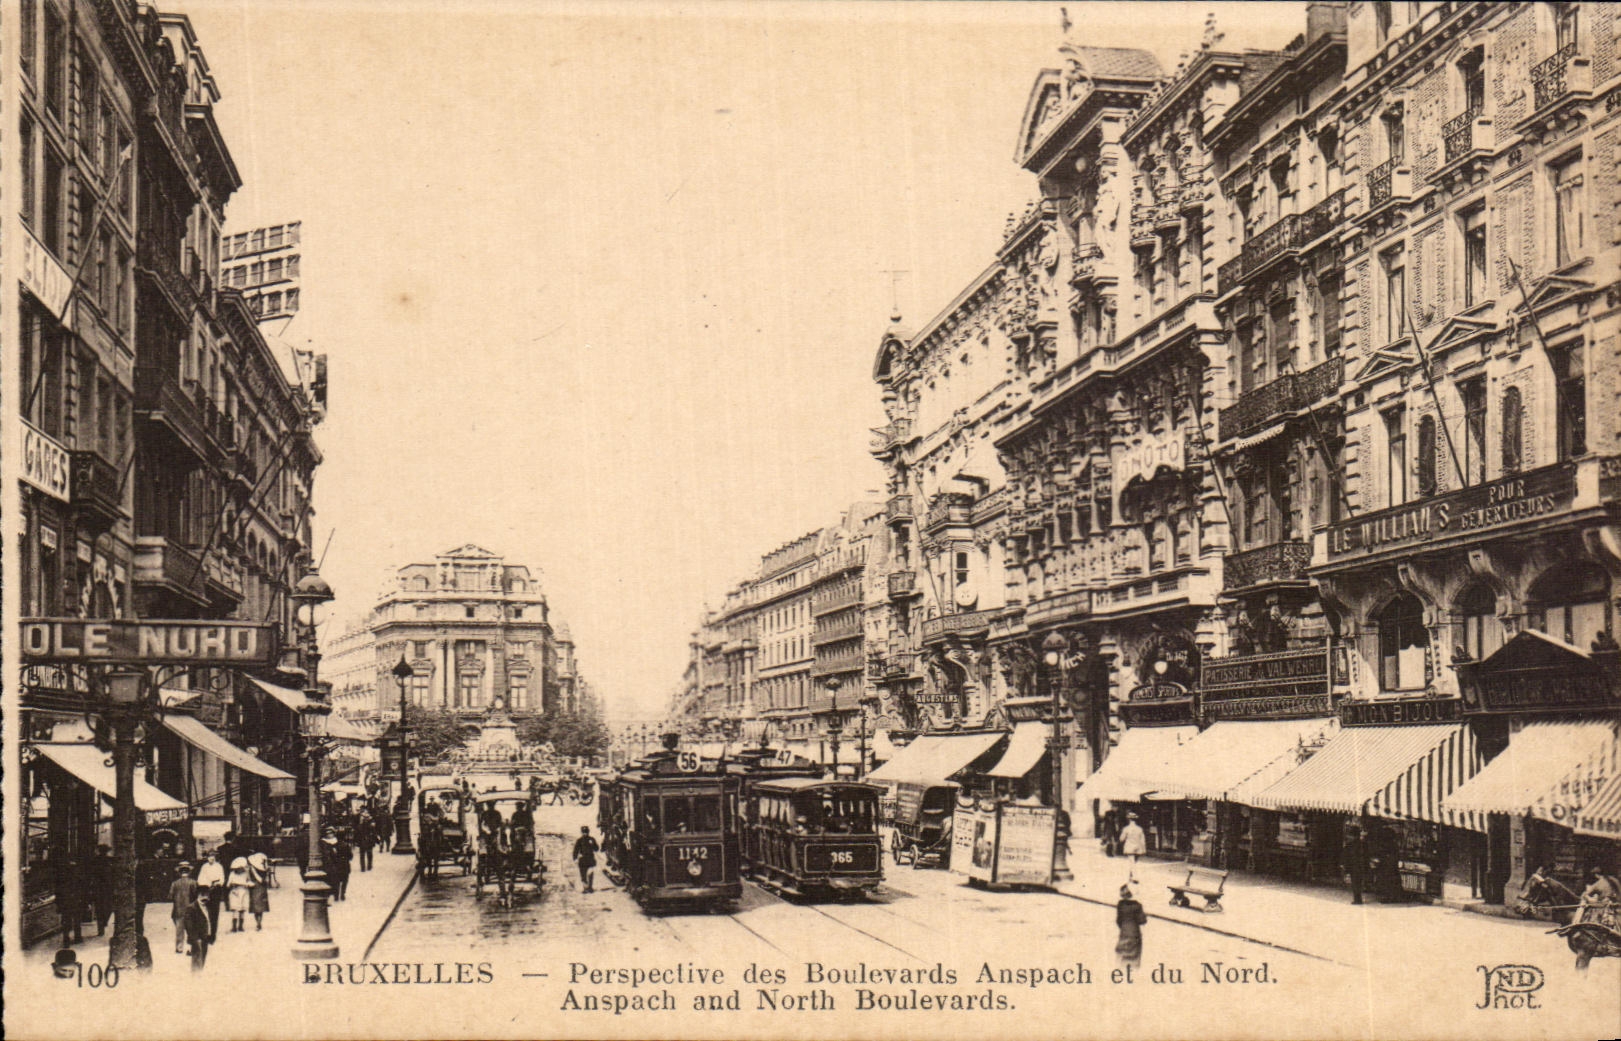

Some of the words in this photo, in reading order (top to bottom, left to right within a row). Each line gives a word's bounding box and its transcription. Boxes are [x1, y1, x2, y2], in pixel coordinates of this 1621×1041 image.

[1489, 480, 1525, 504] POUR
[1334, 527, 1352, 553] LE
[1204, 665, 1252, 682] PATISSERIE
[681, 752, 698, 770] 56
[777, 750, 792, 765] 47
[679, 847, 708, 860] 1142
[831, 851, 853, 863] 365
